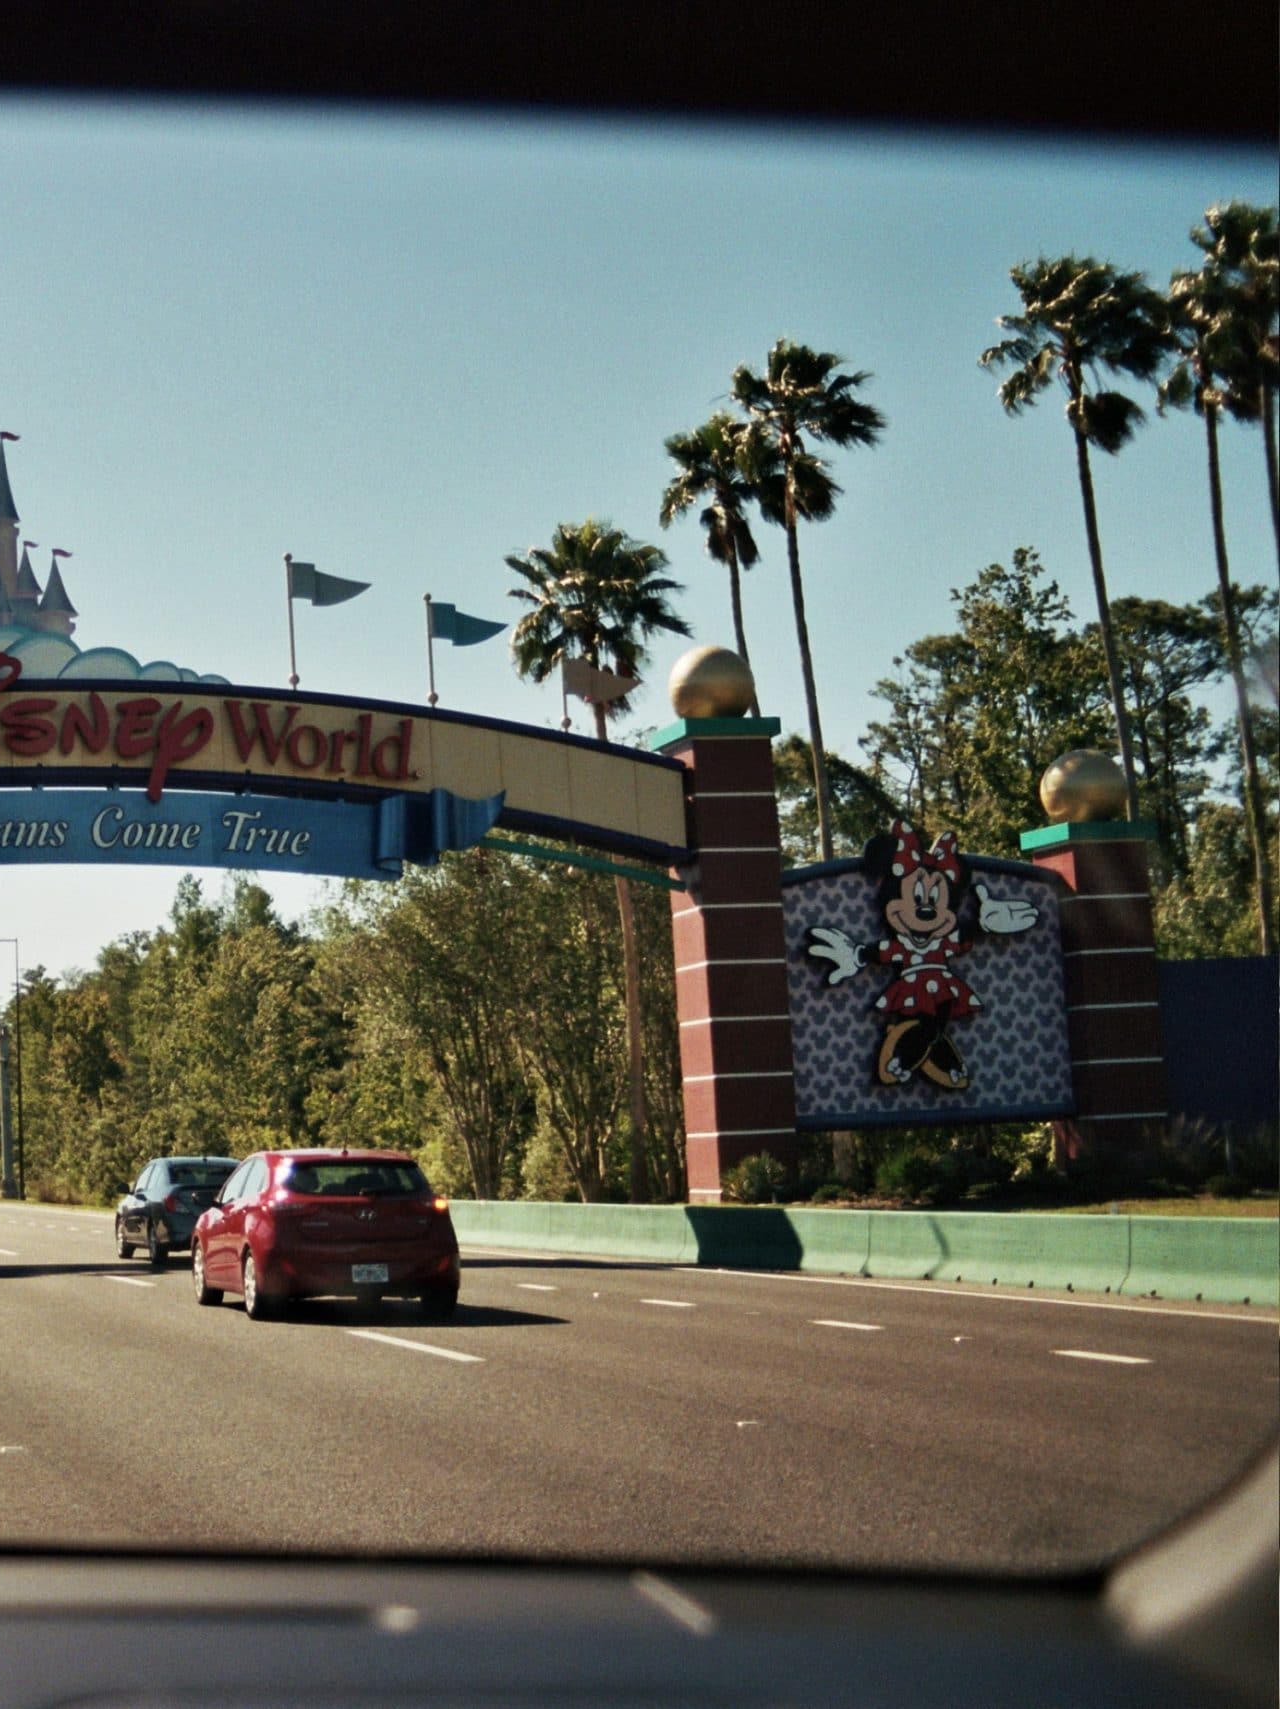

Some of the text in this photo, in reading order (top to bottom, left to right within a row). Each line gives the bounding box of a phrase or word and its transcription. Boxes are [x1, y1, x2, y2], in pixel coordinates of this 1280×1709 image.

[224, 698, 414, 781] World
[90, 808, 201, 851] Come
[222, 811, 311, 856] True
